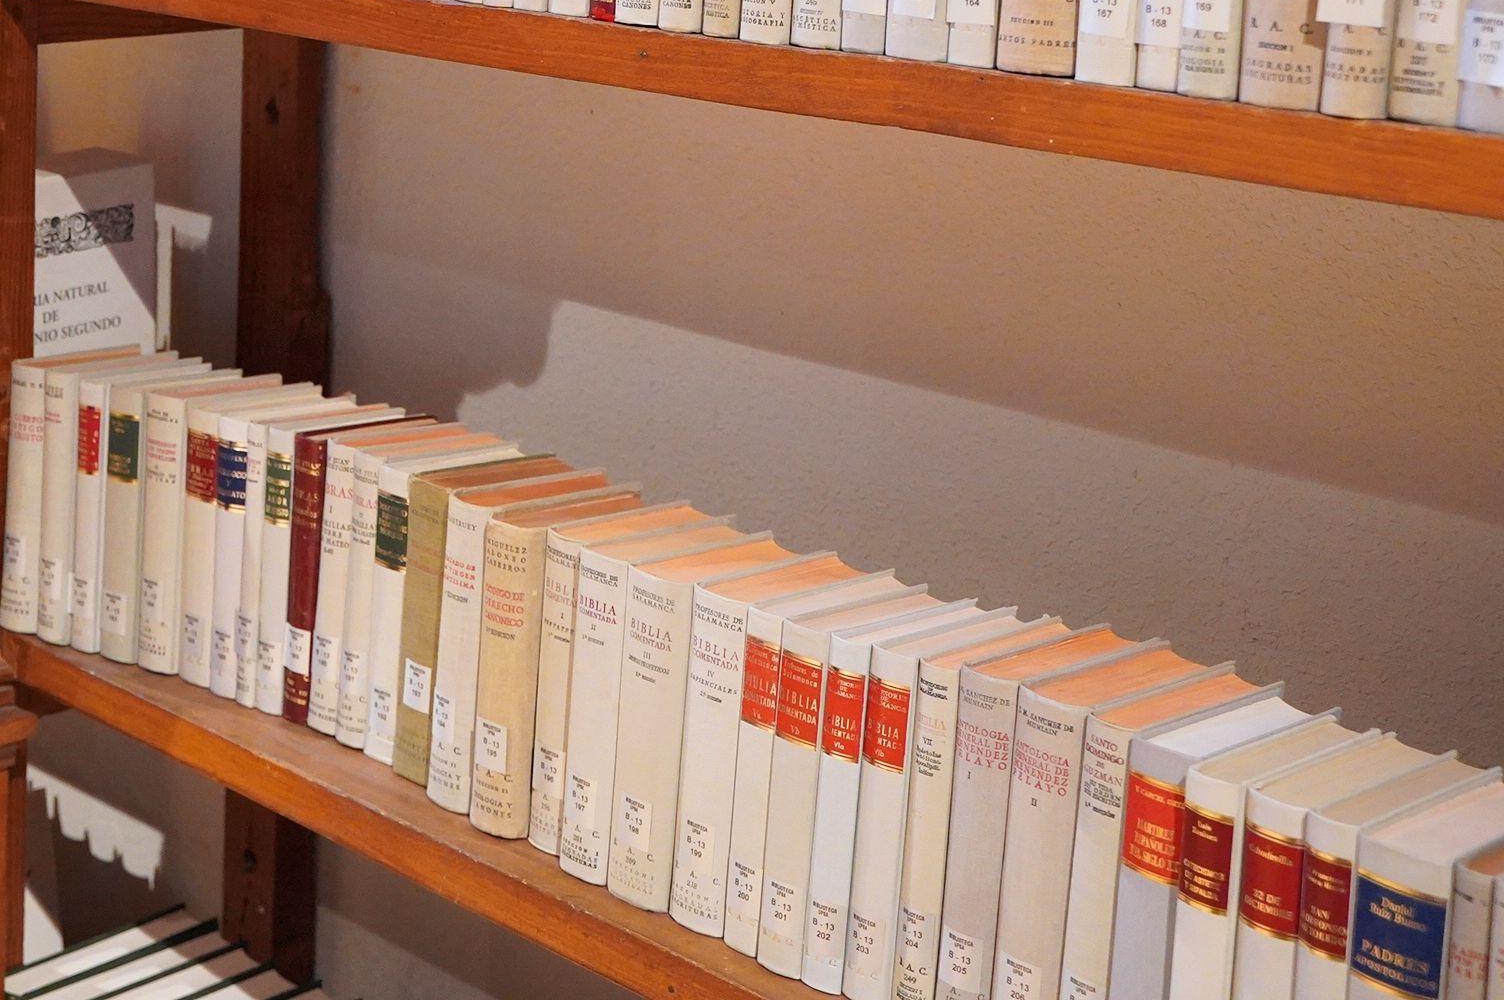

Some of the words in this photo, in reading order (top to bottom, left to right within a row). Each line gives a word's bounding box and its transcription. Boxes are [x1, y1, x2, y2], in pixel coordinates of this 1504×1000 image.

[1096, 8, 1113, 18] 167
[1195, 2, 1212, 12] 169
[1151, 18, 1167, 28] 168
[53, 280, 110, 304] NATURAL
[42, 310, 60, 324] DE
[35, 328, 58, 344] NIO
[60, 315, 122, 339] SEGUNDO
[579, 594, 617, 617] BIBLIA
[632, 594, 675, 614] SALAMANCA
[578, 606, 617, 626] COMENTADA
[694, 611, 743, 633] SALAMANCA
[732, 617, 744, 626] DE
[630, 617, 673, 642] BIBLIA
[630, 631, 673, 652] COMENTADA
[693, 635, 740, 662] BIBLIA
[692, 649, 739, 672] COMENTADA
[707, 670, 715, 678] IV
[966, 688, 998, 704] SANCHEZ
[957, 719, 1010, 742] NTOLOGIA
[994, 741, 1010, 751] DE
[1090, 734, 1118, 752] SANTO
[486, 748, 497, 758] 195
[1085, 742, 1125, 766] DOMINGO
[1054, 766, 1070, 777] DE
[575, 802, 586, 812] 197
[628, 824, 640, 835] 198
[690, 848, 703, 859] 199
[737, 890, 750, 902] 200
[774, 910, 787, 921] 201
[816, 929, 831, 941] 202
[856, 943, 870, 955] 203
[904, 938, 919, 949] 204
[952, 963, 967, 975] 205
